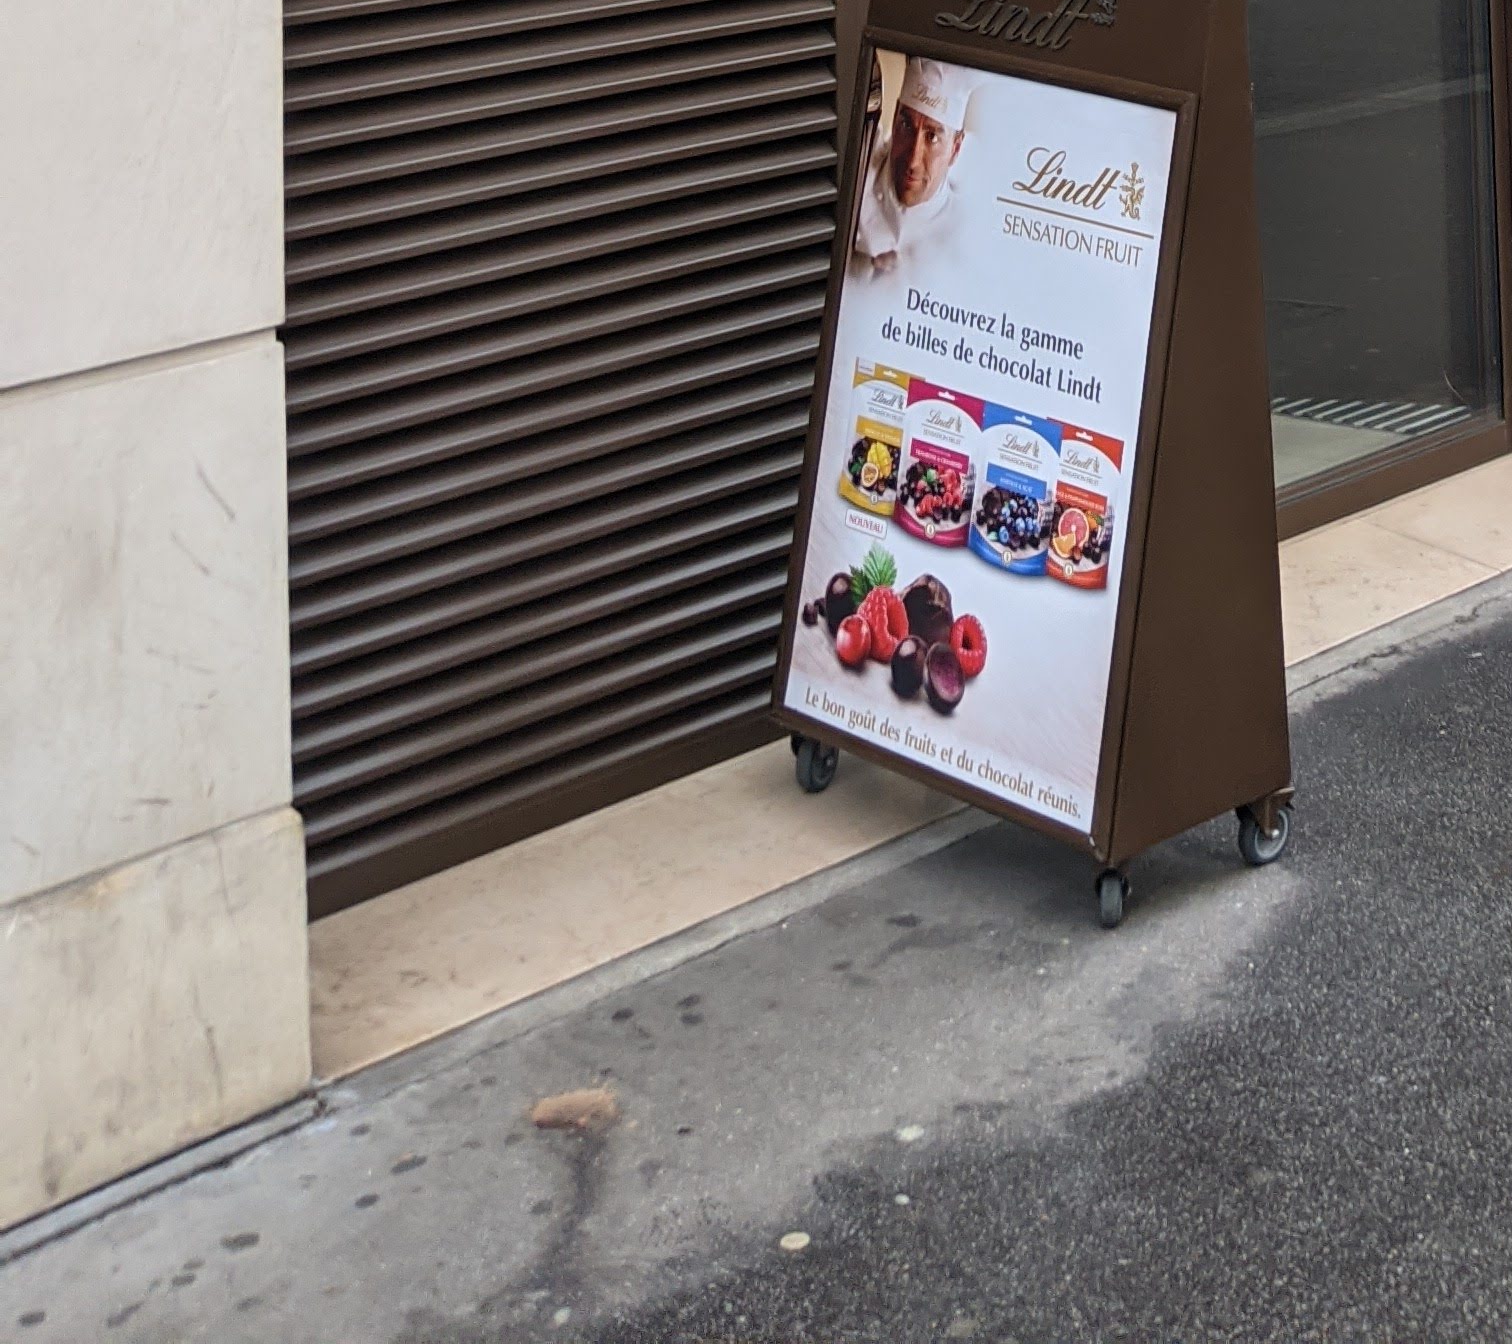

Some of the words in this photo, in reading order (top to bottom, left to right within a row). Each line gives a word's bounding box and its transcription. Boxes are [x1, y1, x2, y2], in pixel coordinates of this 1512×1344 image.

[1012, 147, 1120, 210] Lindt
[1002, 213, 1093, 255] SENSATION
[1095, 236, 1144, 268] FRUIT
[906, 288, 996, 335] Découvrez
[1000, 313, 1015, 341] la
[1019, 326, 1084, 360] gamme
[881, 316, 901, 343] de
[905, 321, 948, 356] billes
[953, 337, 974, 364] de
[978, 345, 1052, 389] chocolat
[1057, 368, 1102, 404] Lindt
[925, 408, 956, 430] Lindt
[1002, 432, 1033, 455] Lindt
[804, 686, 819, 706] Le
[822, 691, 845, 720] bon
[848, 710, 877, 732] goût
[879, 717, 901, 742] des
[904, 727, 937, 758] fruits
[940, 746, 952, 764] et
[956, 750, 974, 773] du
[977, 760, 1034, 799] chocolat
[1037, 785, 1081, 819] réunis.
